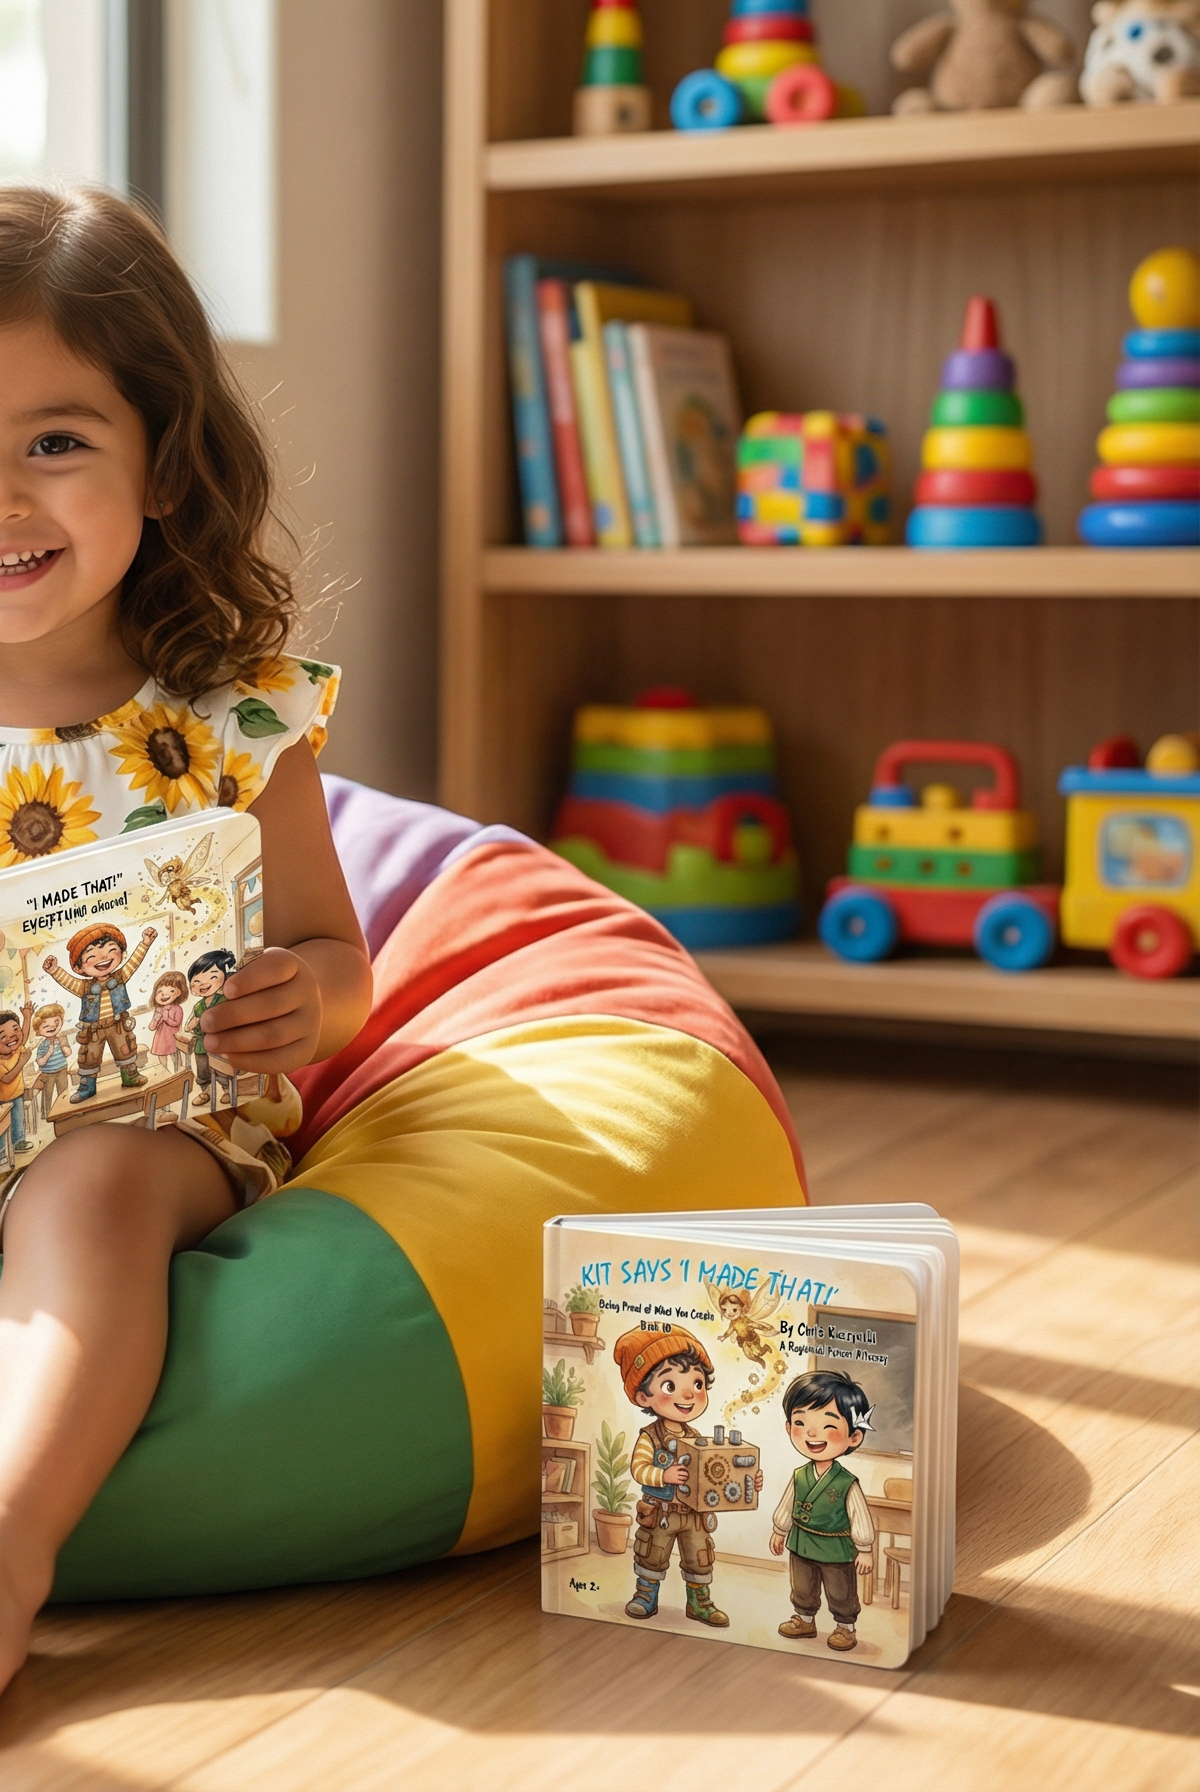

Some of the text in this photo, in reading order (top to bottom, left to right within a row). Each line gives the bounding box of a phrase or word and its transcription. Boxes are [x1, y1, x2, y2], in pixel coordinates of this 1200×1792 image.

[42, 886, 79, 909] MADE
[80, 873, 123, 896] THAT!"
[581, 1262, 612, 1287] KIT
[621, 1258, 672, 1284] SAYS
[698, 1260, 760, 1290] MADE
[780, 1320, 795, 1339] By
